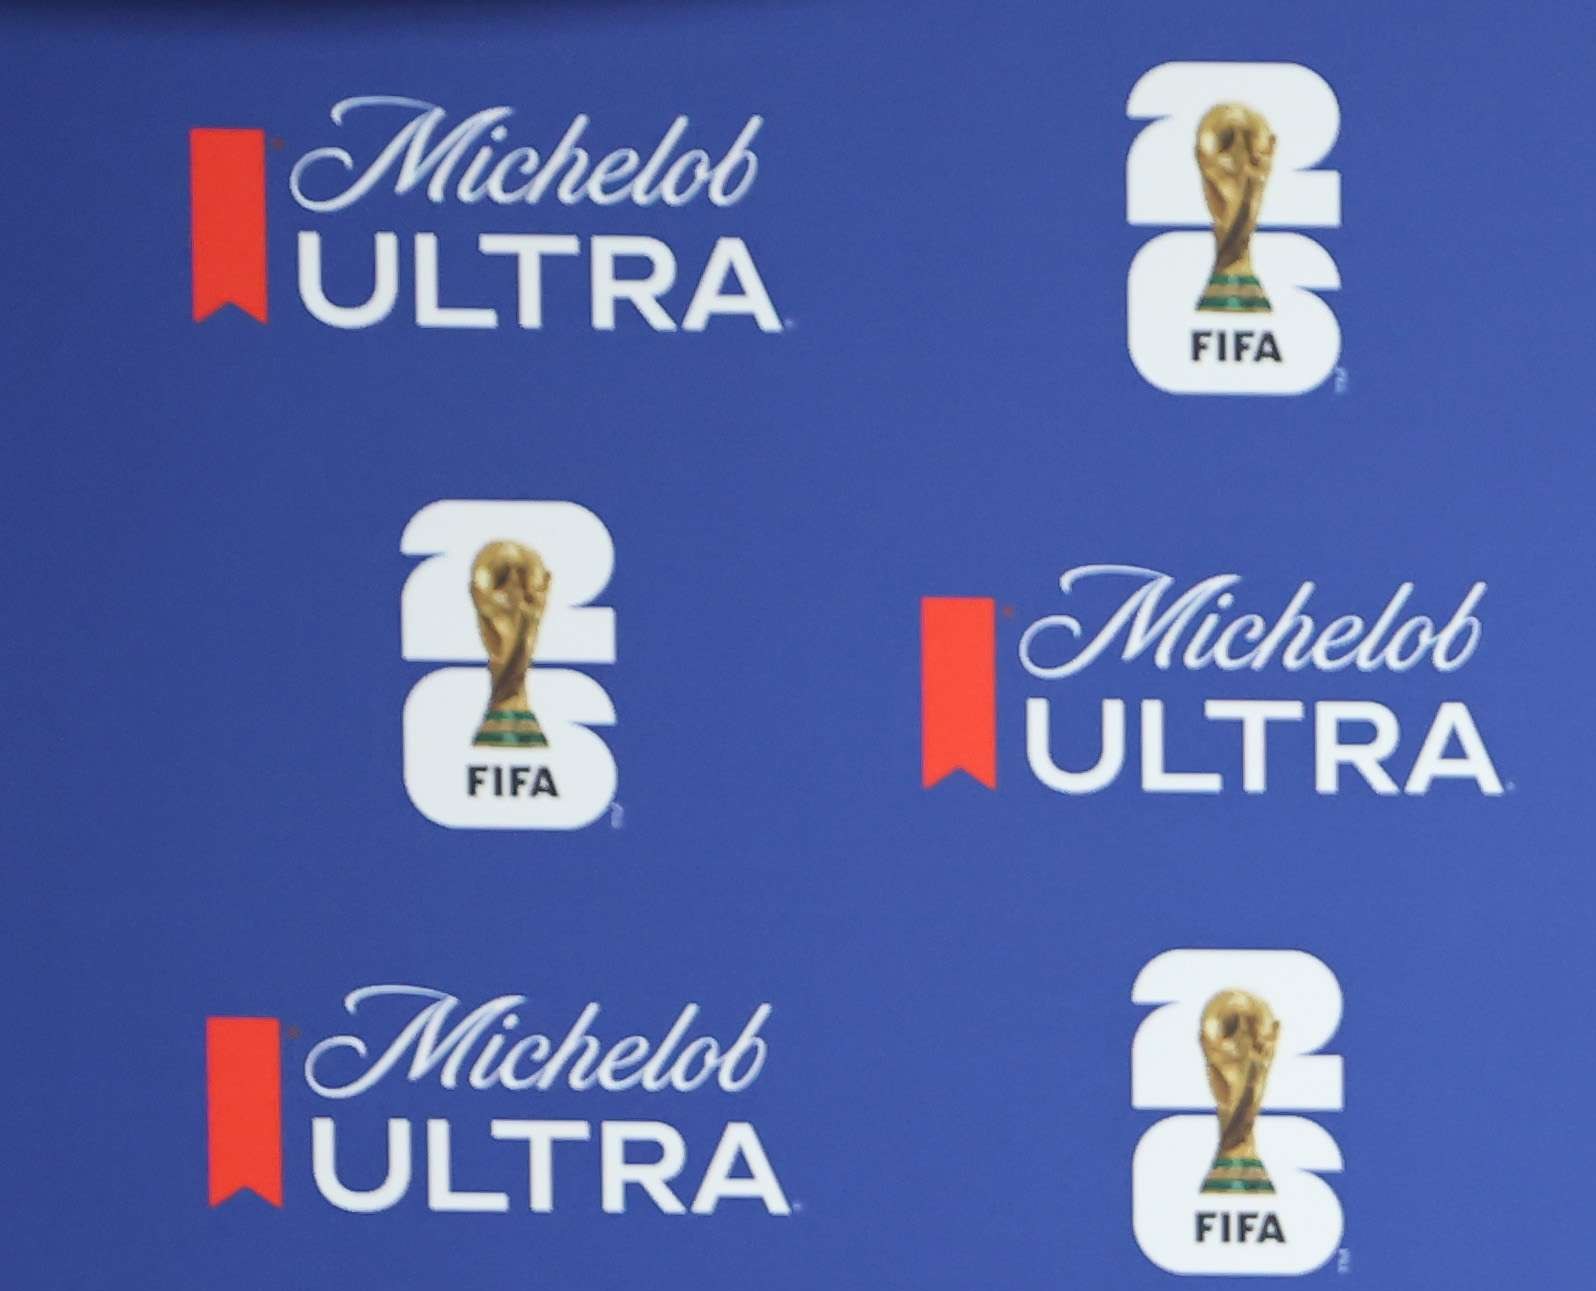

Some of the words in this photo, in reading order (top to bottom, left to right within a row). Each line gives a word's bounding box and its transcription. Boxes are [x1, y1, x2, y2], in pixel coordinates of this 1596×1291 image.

[290, 97, 762, 212] Michelob
[298, 231, 782, 332] ULTRA
[1191, 330, 1283, 363] FIFA
[1019, 565, 1486, 678] Michelob
[467, 765, 559, 798] FIFA
[1026, 698, 1504, 795] ULTRA
[305, 985, 771, 1098] Michelob
[312, 1117, 790, 1215] ULTRA
[1195, 1212, 1286, 1244] FIFA
